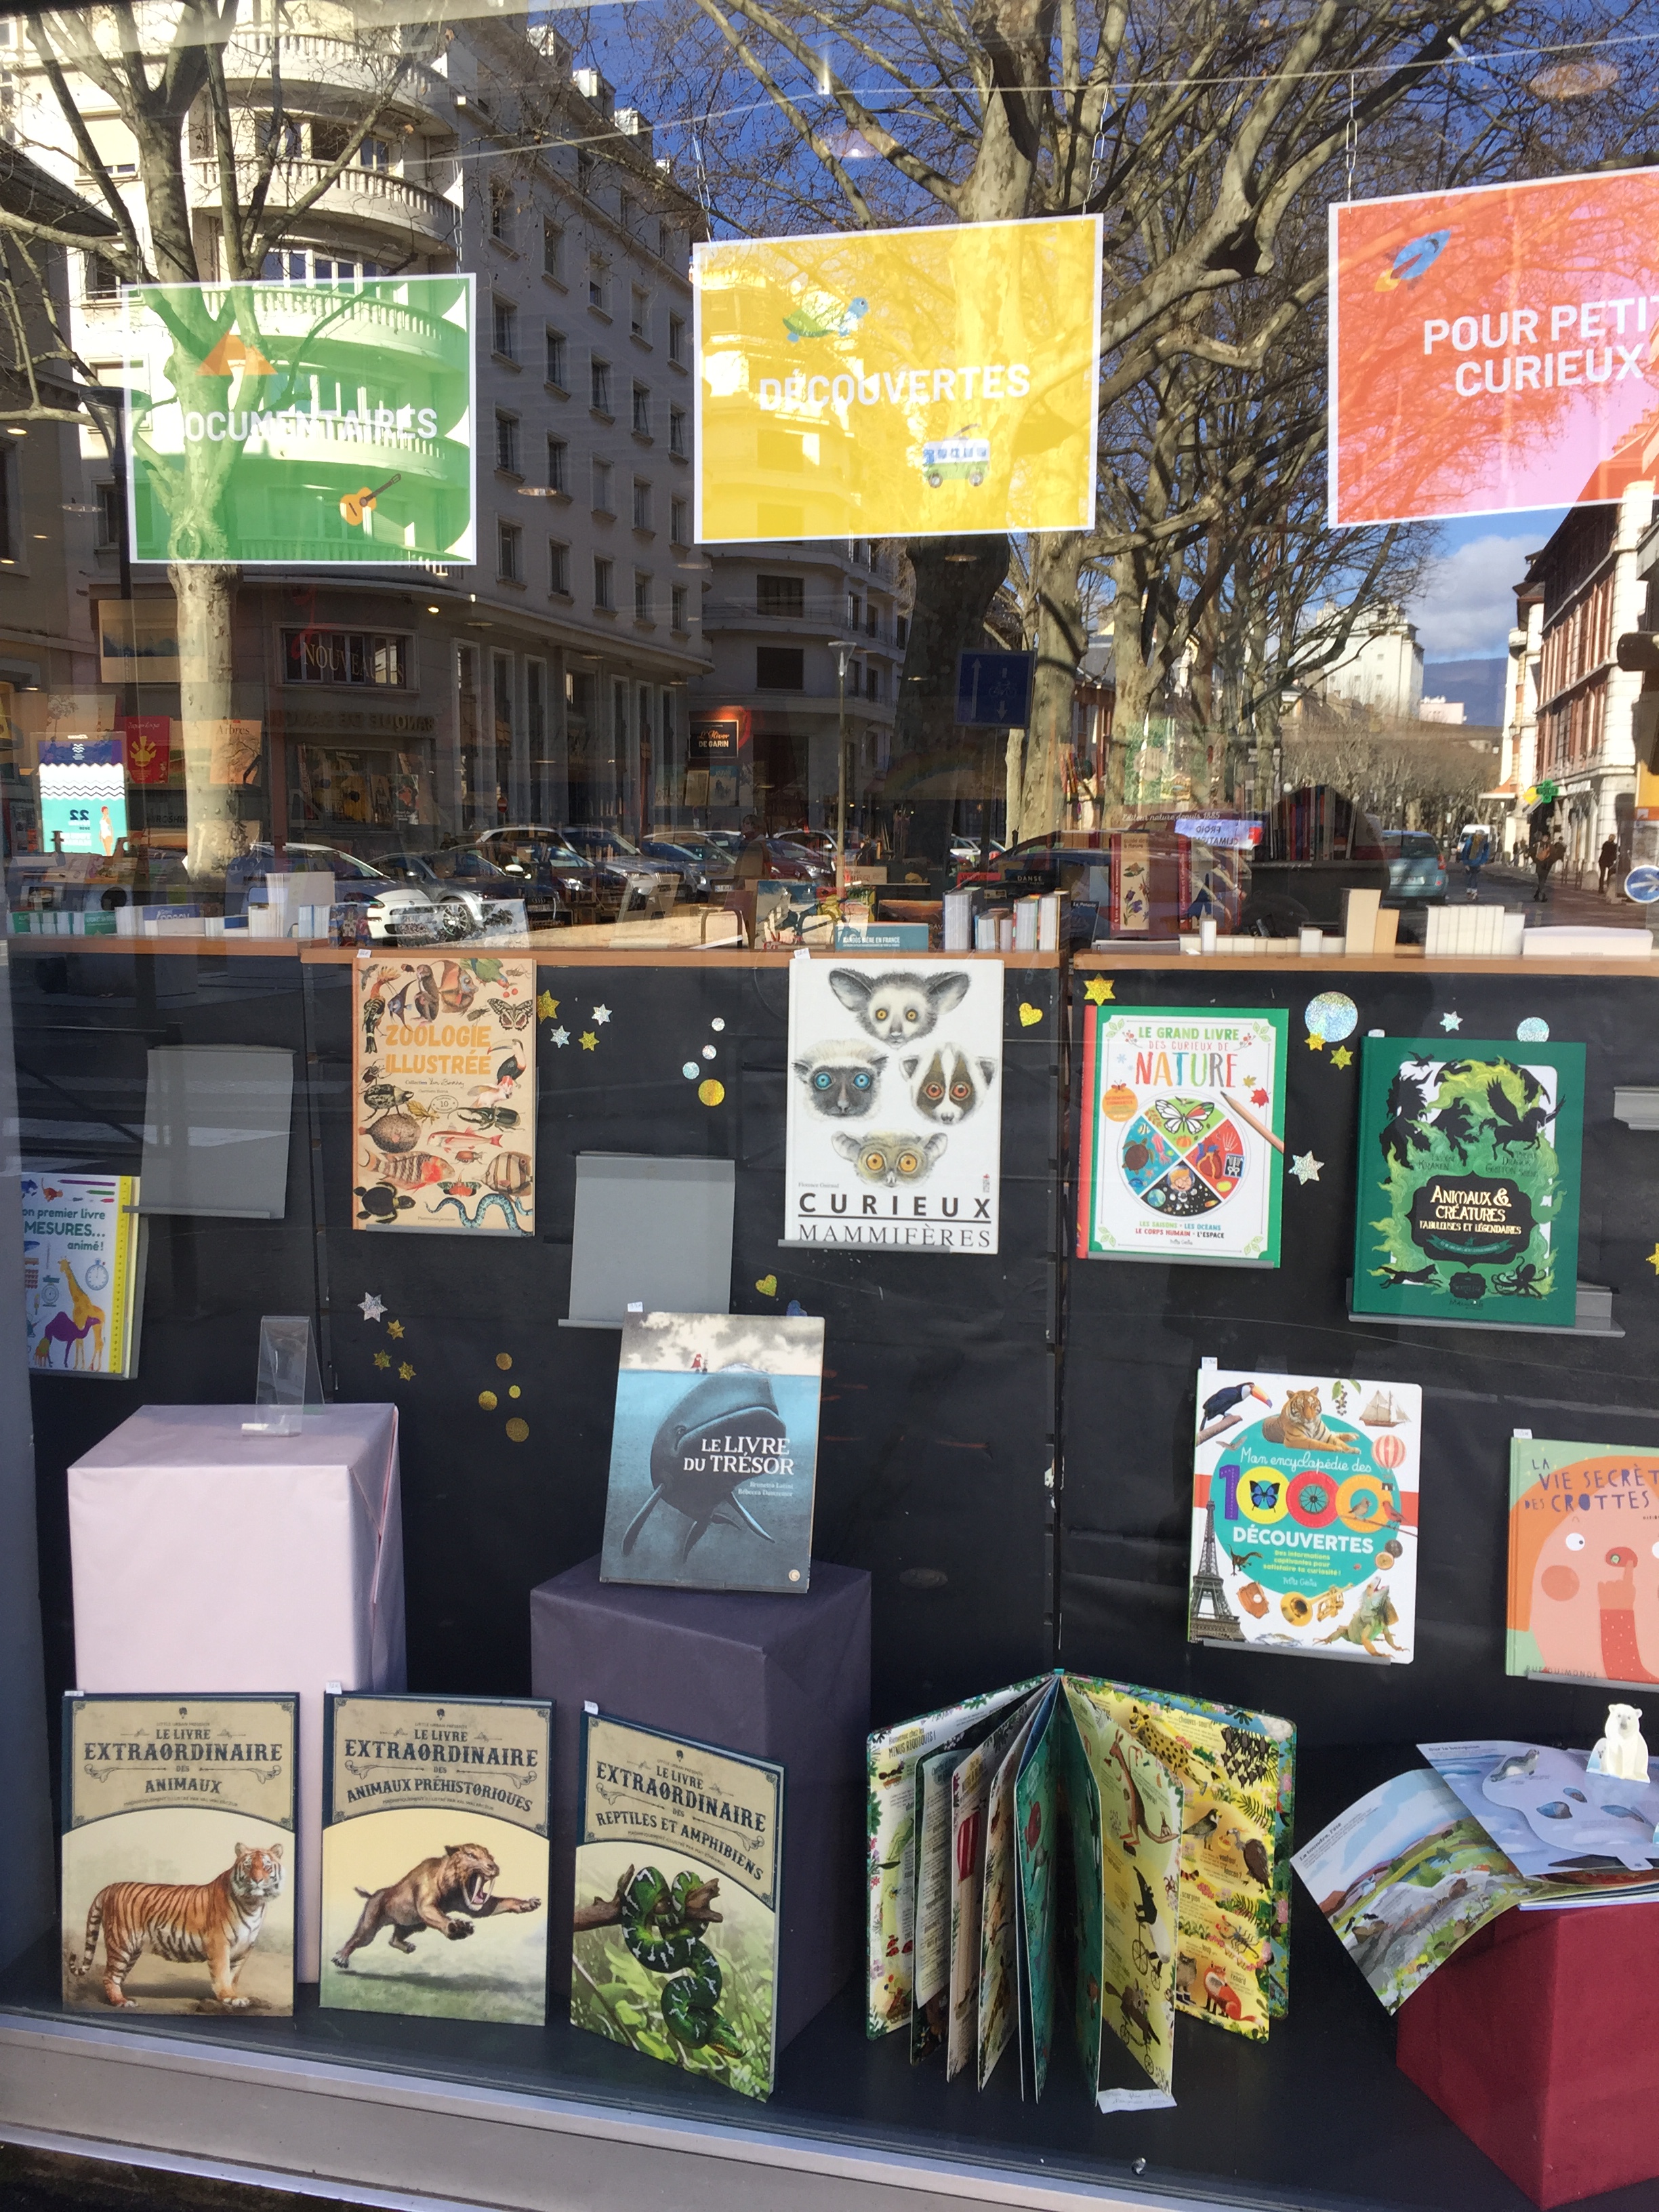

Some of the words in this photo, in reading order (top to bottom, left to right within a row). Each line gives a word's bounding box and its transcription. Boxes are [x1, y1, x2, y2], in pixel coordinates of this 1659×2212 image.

[1423, 308, 1538, 355] POUR
[1455, 343, 1643, 396] CURIEUX
[759, 363, 1031, 411] DÉCOUVERTES
[178, 408, 438, 442] OCUMENTAIRES
[216, 723, 250, 735] Arbres
[1149, 813, 1176, 821] nature
[1202, 811, 1221, 820] 1885
[385, 1025, 492, 1048] ZOOLOGIE
[1138, 1027, 1152, 1039] LE
[1157, 1027, 1199, 1040] GRAND
[1204, 1027, 1239, 1040] LIVRE
[1149, 1041, 1166, 1050] DES
[1168, 1041, 1212, 1051] CURIEUX
[1218, 1042, 1229, 1051] DE
[384, 1051, 492, 1076] ILLUSTRÉE
[1135, 1051, 1238, 1088] NATURE
[799, 1192, 991, 1218] CURIEUX
[1430, 1185, 1492, 1206] ANIMAUX
[1493, 1187, 1512, 1208] &
[37, 1208, 79, 1220] premier
[81, 1208, 106, 1220] livre
[1435, 1204, 1506, 1223] CRÉATURES
[24, 1221, 106, 1237] MESURES...
[798, 1223, 991, 1248] MAMMIFÈRES
[1419, 1220, 1461, 1232] FABULEUSES
[1463, 1221, 1474, 1232] ET
[1475, 1221, 1521, 1235] LÉGENDAIRES
[701, 1438, 720, 1453] LE
[724, 1435, 792, 1456] LIVRE
[682, 1457, 705, 1472] DU
[709, 1452, 795, 1476] TRÉSOR
[1240, 1447, 1269, 1466] Mon
[1270, 1451, 1350, 1475] encyclopédie
[1351, 1460, 1372, 1474] des
[1532, 1458, 1550, 1471] LA
[1538, 1471, 1574, 1491] VIE
[1218, 1464, 1395, 1534] 1000
[1524, 1498, 1545, 1511] DES
[1551, 1490, 1650, 1513] CROTTES
[1233, 1525, 1374, 1555] DÉCOUVERTES
[1273, 1557, 1312, 1567] captivantes
[1288, 1551, 1330, 1561] informations
[1263, 1563, 1296, 1572] satisfaire
[1307, 1568, 1337, 1576] curiosité
[1563, 1668, 1598, 1679] MONDE
[156, 1729, 170, 1740] LE
[173, 1729, 211, 1740] LIVRE
[414, 1729, 428, 1740] LE
[431, 1730, 468, 1742] LIVRE
[84, 1742, 283, 1762] EXTRAORDINAIRE
[344, 1739, 538, 1767] EXTRAORDINAIRE
[888, 1742, 906, 1759] MINUS
[433, 1765, 447, 1774] DES
[657, 1765, 669, 1777] LE
[671, 1770, 703, 1790] LIVRE
[145, 1777, 222, 1794] ANIMAUX
[346, 1778, 412, 1803] ANIMAUX
[414, 1776, 533, 1813] PRÉHISTORIQUES
[596, 1761, 766, 1832] EXTRAORDINAIRE
[672, 1807, 684, 1818] DES
[596, 1810, 658, 1828] REPTILES
[661, 1817, 678, 1834] ET
[680, 1824, 764, 1881] AMPHIBIENS
[1299, 1853, 1307, 1862] La
